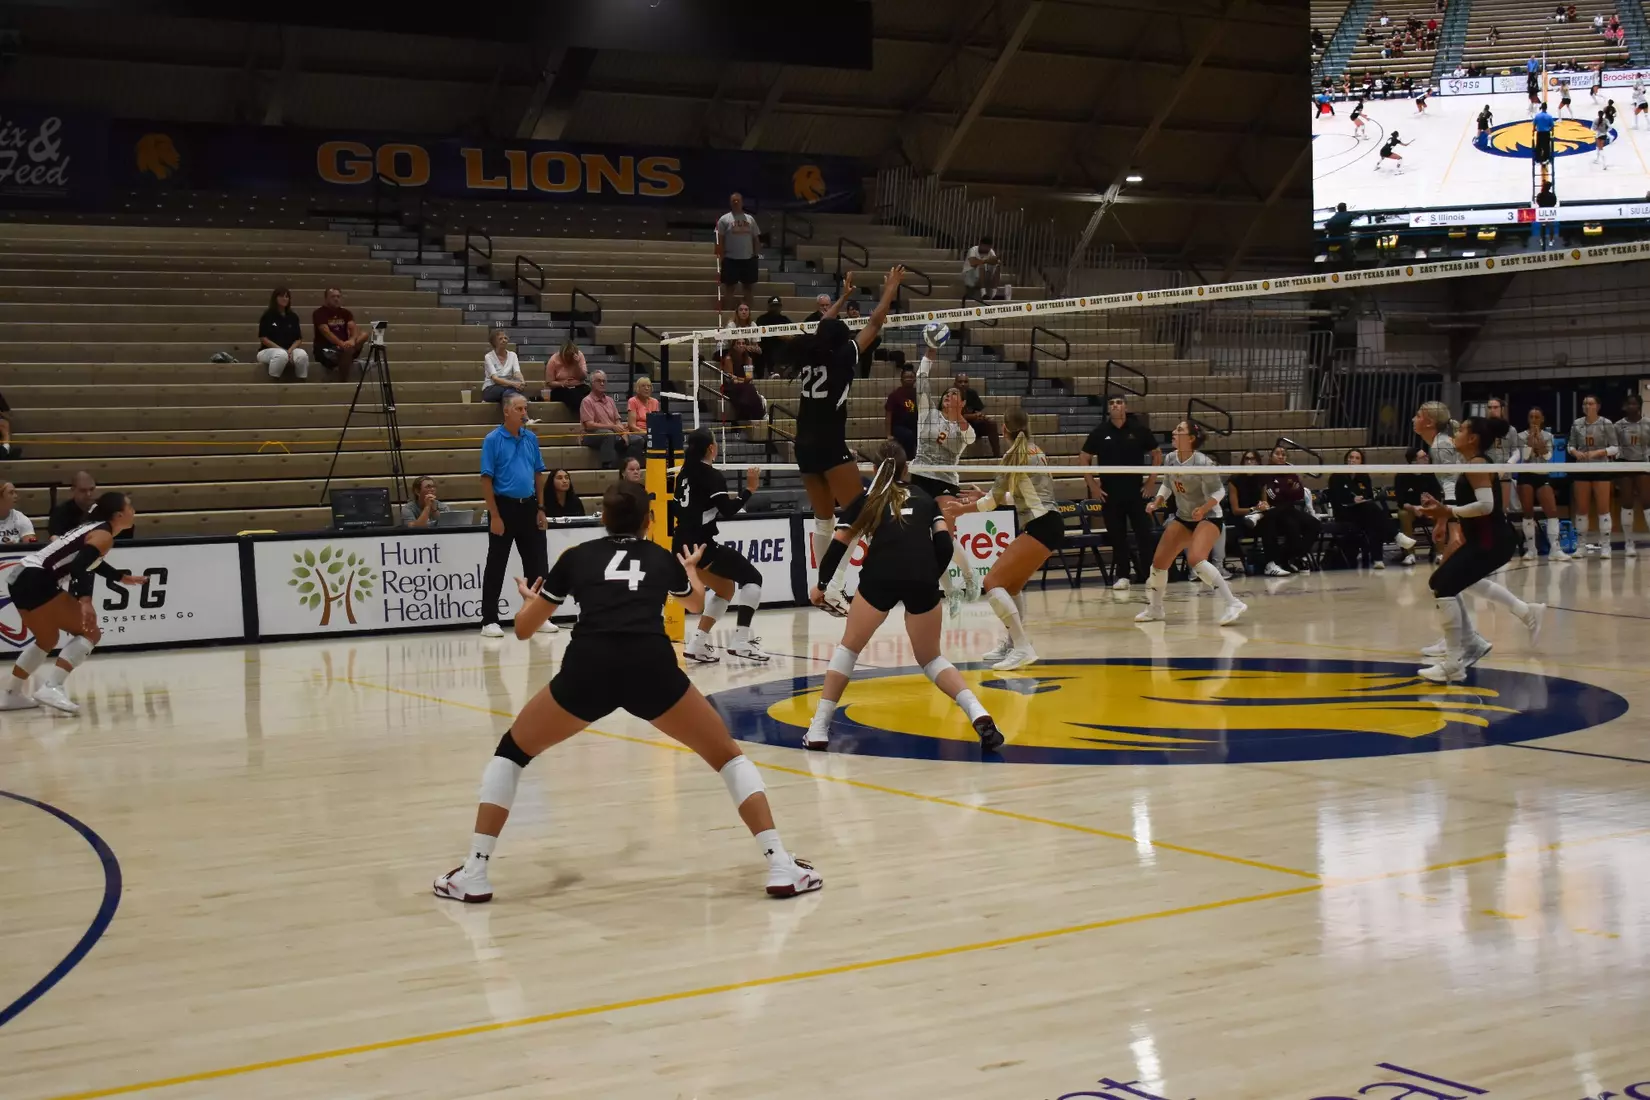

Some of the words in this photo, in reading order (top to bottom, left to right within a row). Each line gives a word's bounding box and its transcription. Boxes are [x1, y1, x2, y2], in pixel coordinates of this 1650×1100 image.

[0, 120, 28, 148] ix
[27, 116, 62, 163] &
[317, 140, 431, 187] GO
[460, 147, 685, 197] LIONS
[1430, 214, 1436, 222] S
[1438, 213, 1466, 221] Illinois
[1507, 211, 1514, 221] 3
[1538, 209, 1557, 217] ULM
[1617, 207, 1623, 216] 1
[1587, 248, 1609, 257] EAST
[1612, 245, 1637, 255] TEXAS
[1501, 257, 1520, 266] EAST
[1522, 255, 1547, 265] TEXAS
[1420, 265, 1436, 273] EAST
[1439, 263, 1462, 272] TEXAS
[1344, 273, 1361, 281] EAST
[1363, 270, 1384, 279] TEXAS
[1291, 278, 1312, 286] TEXAS
[800, 365, 829, 399] 22
[936, 431, 948, 445] 2
[679, 478, 691, 508] 3
[1058, 504, 1077, 513] ONS
[0, 527, 19, 537] ONS
[381, 541, 442, 566] Hunt
[604, 550, 647, 591] 4
[382, 563, 482, 601] Regional
[102, 566, 169, 611] SG
[384, 593, 509, 623] Healthcae
